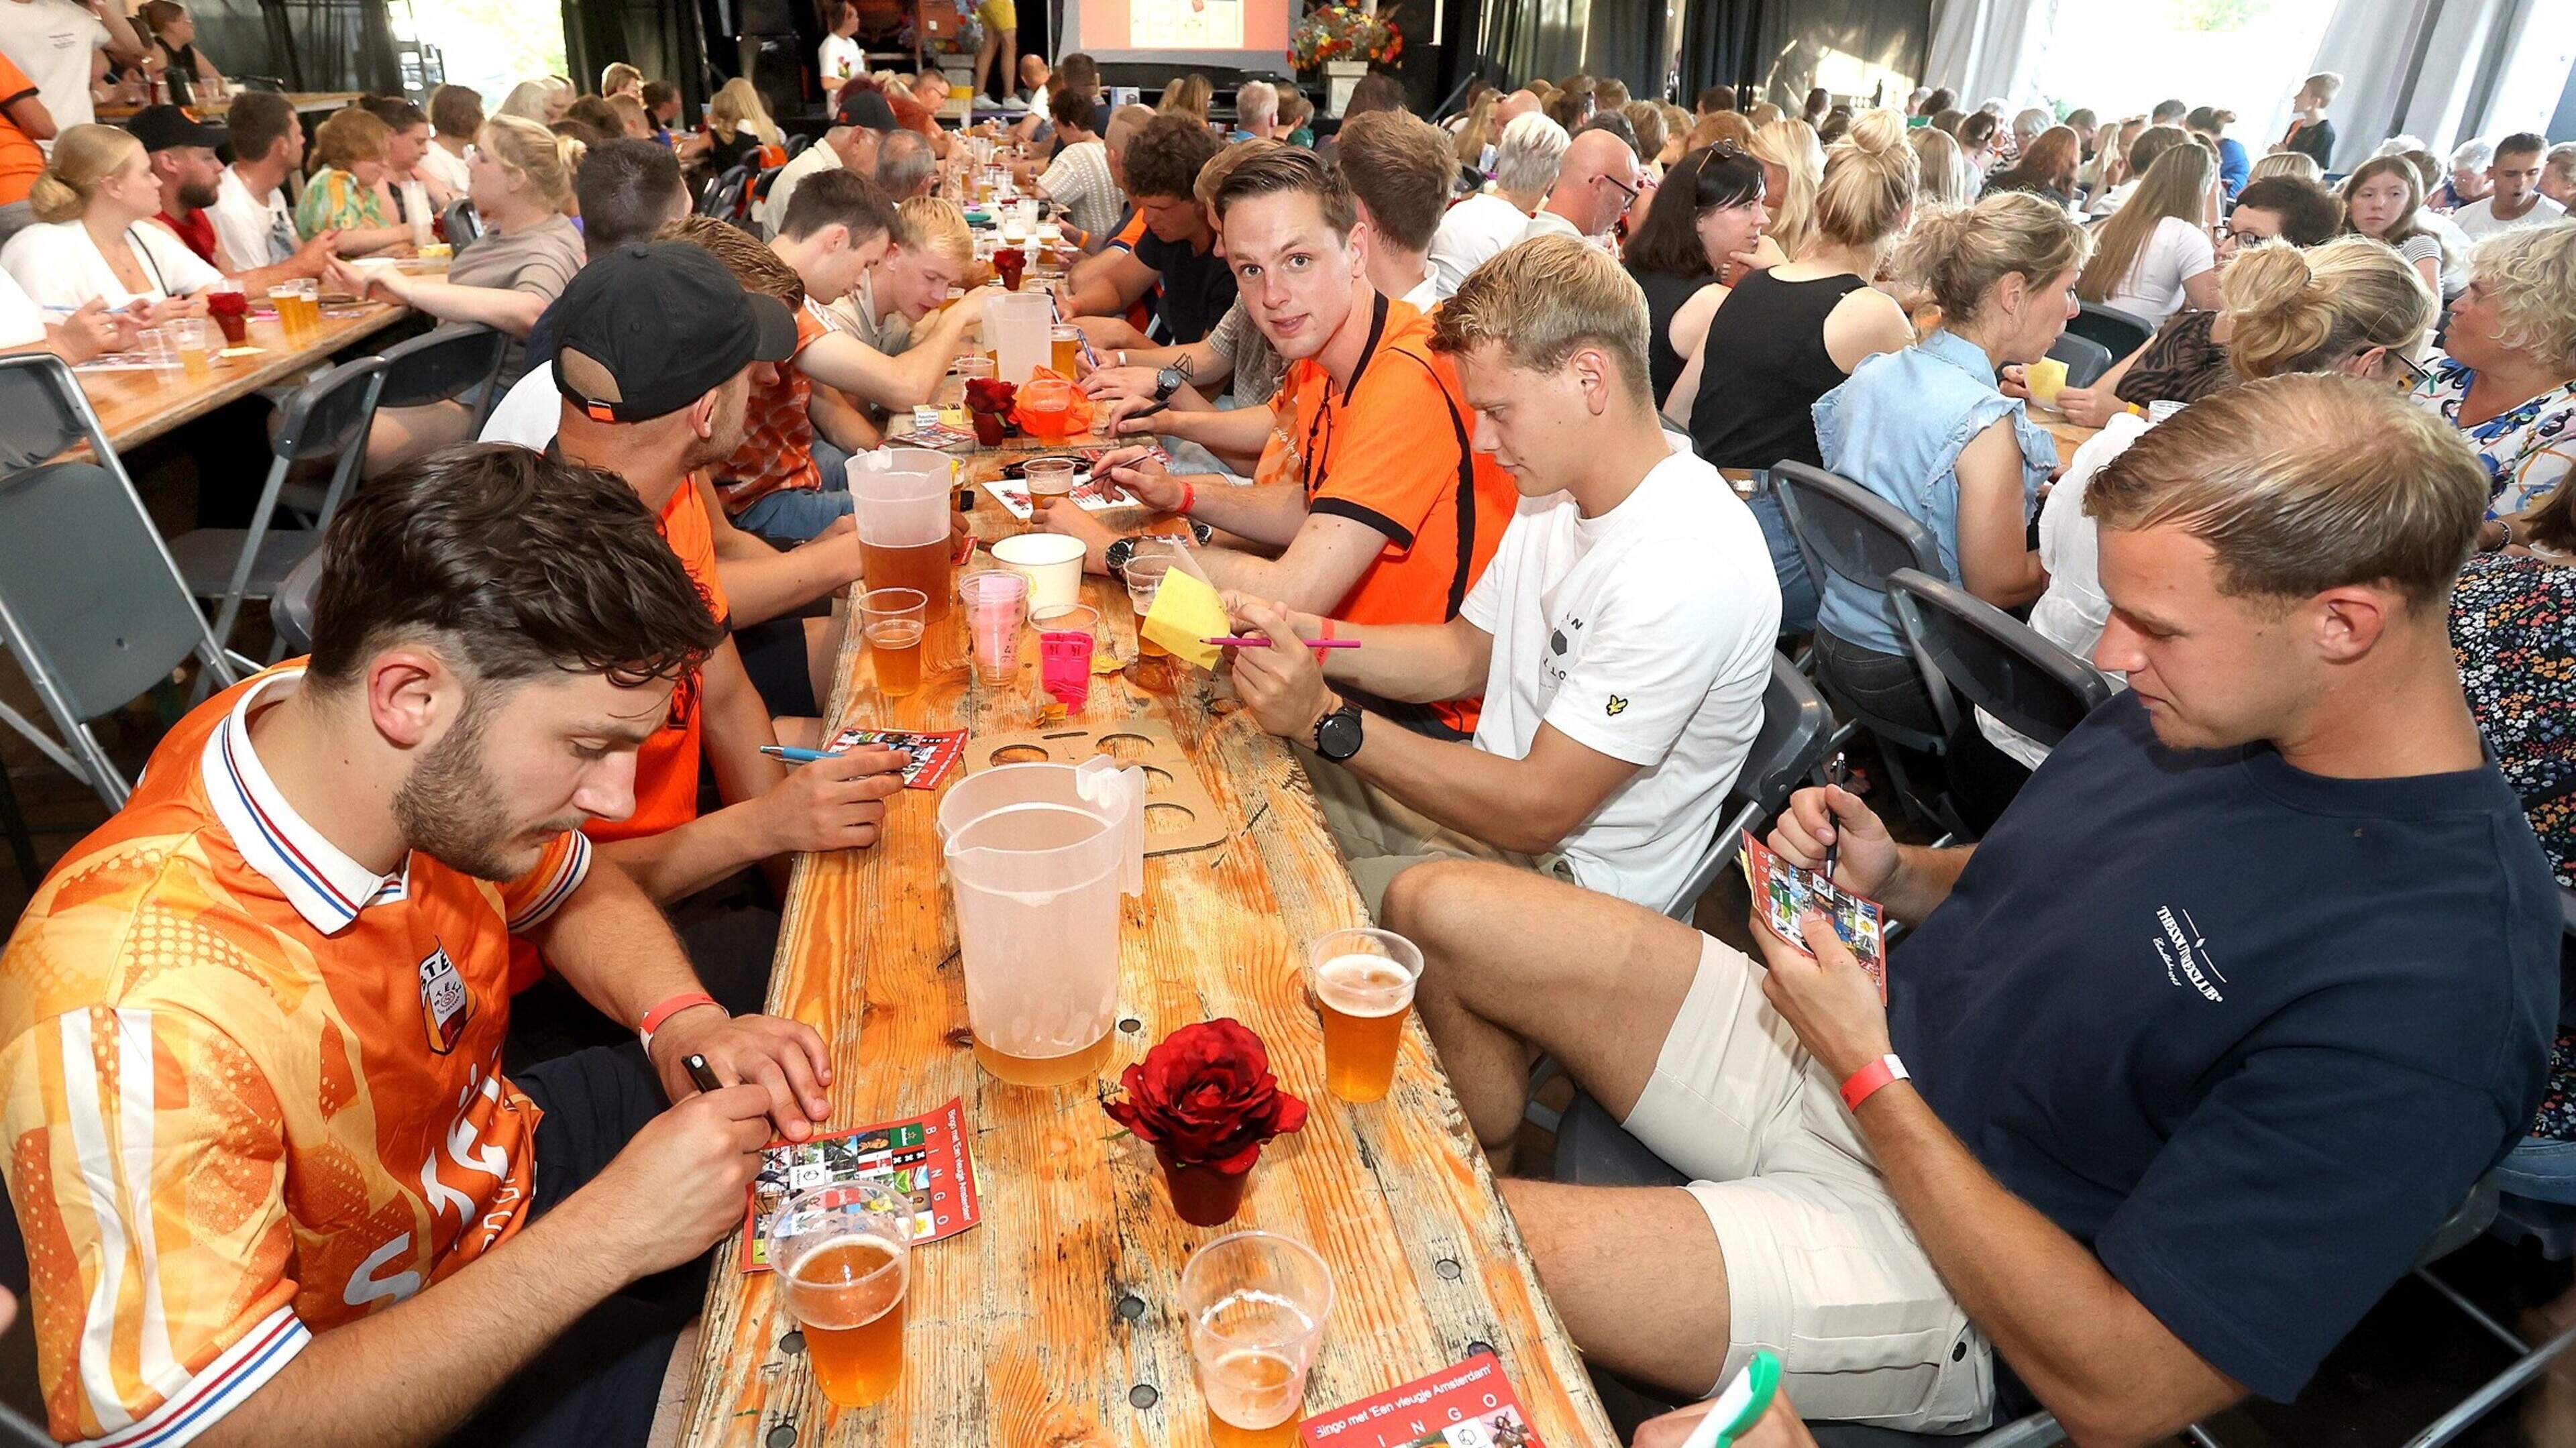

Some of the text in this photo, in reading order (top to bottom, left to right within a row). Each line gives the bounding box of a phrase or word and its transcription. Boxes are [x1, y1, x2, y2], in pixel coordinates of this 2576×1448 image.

[947, 1109, 957, 1129] Bingo
[951, 1129, 960, 1143] met
[1347, 1410, 1369, 1427] met
[1395, 1389, 1432, 1409] vleugje
[1433, 1362, 1491, 1396] Amsterdam'
